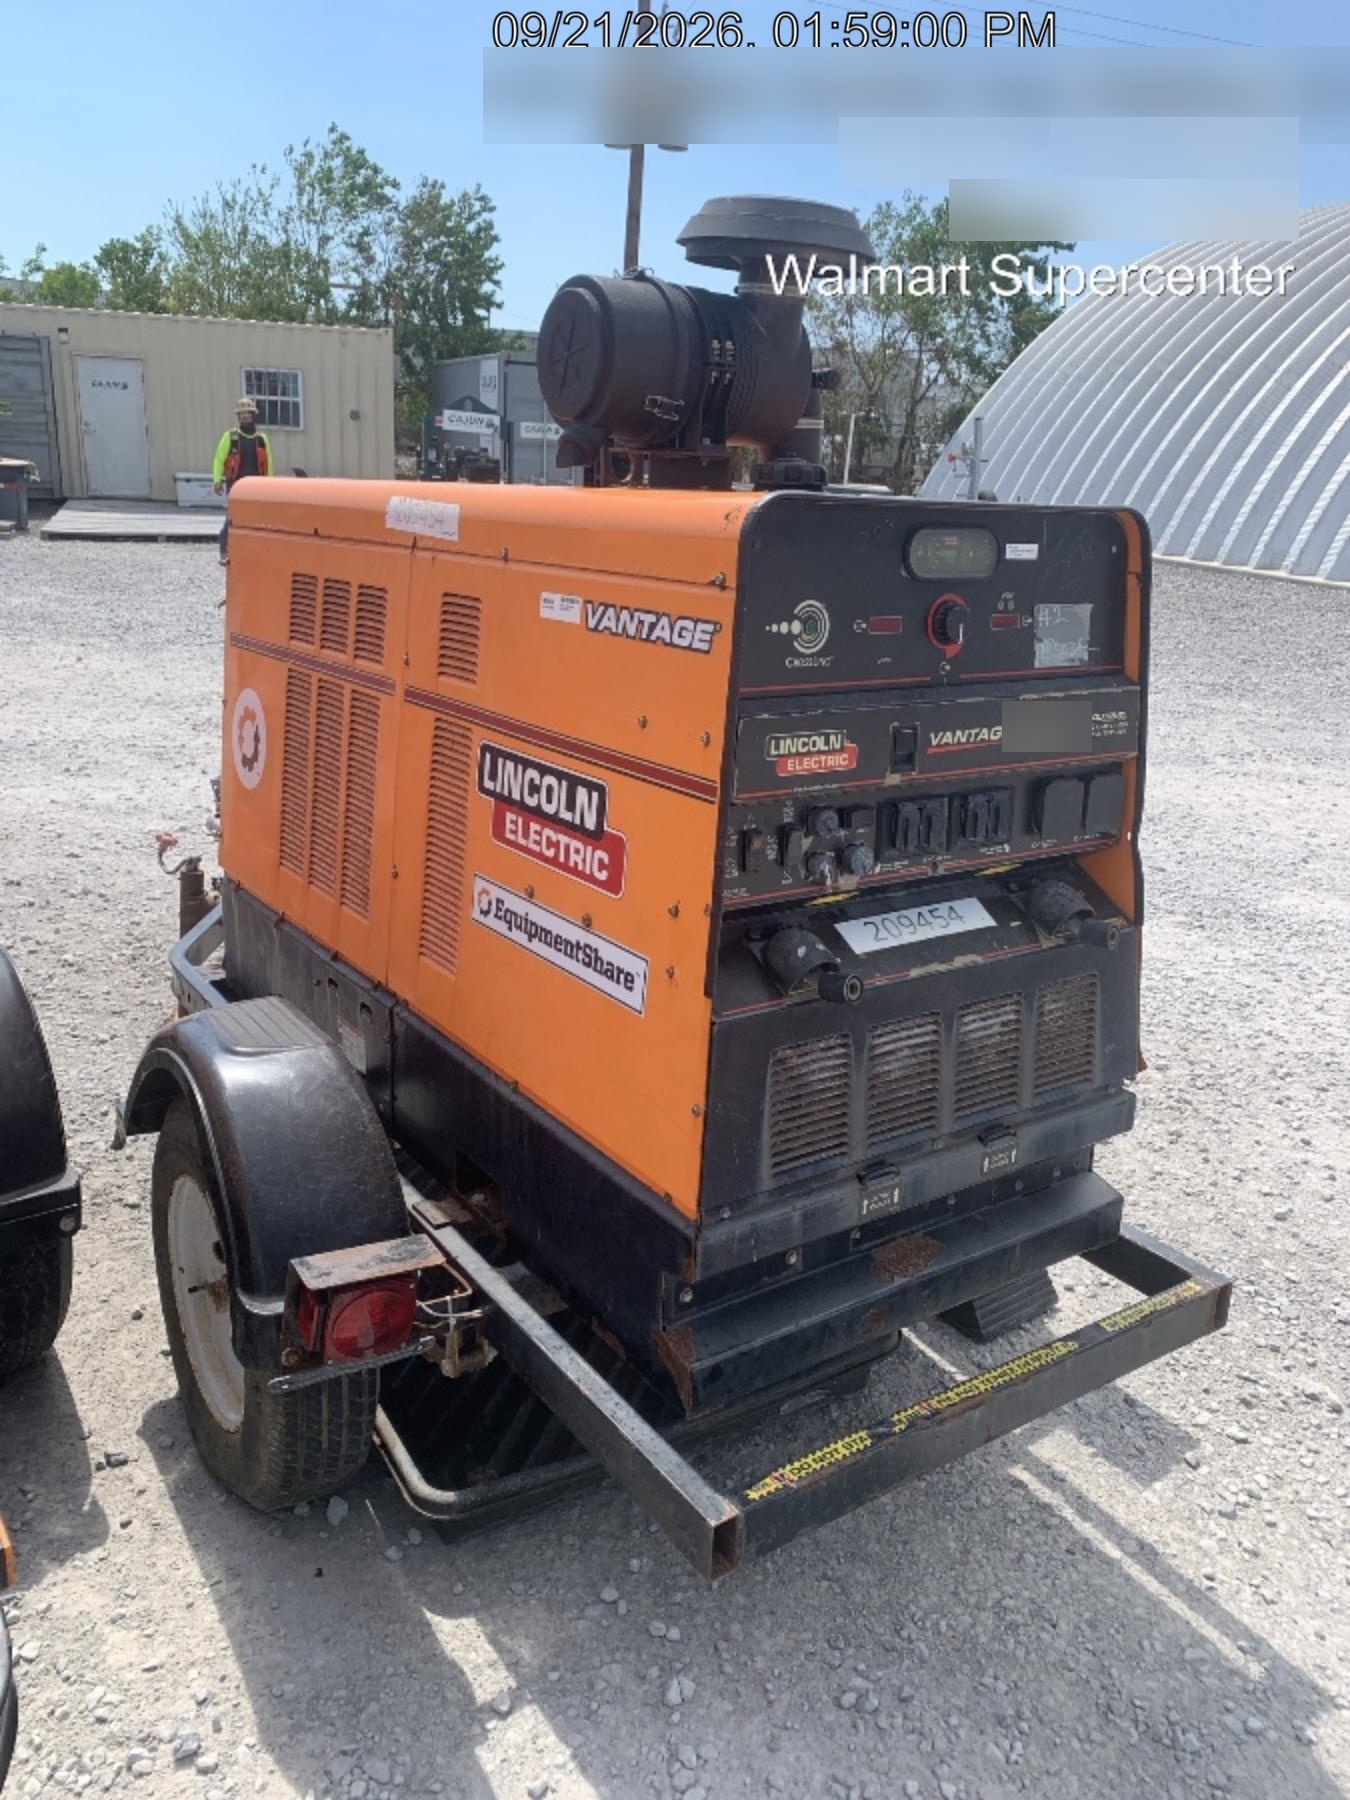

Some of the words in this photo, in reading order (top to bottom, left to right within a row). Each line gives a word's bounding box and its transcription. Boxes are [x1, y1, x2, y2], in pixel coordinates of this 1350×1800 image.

[585, 601, 716, 652] VANTAGE
[770, 734, 842, 756] LINCOLN
[930, 726, 1002, 746] VANTAG
[787, 754, 849, 771] ELECTRIC
[482, 751, 598, 831] LINCOLN
[505, 811, 609, 881] ELECTRIC
[494, 898, 635, 993] EquipmentShare
[863, 905, 964, 943] 209454
